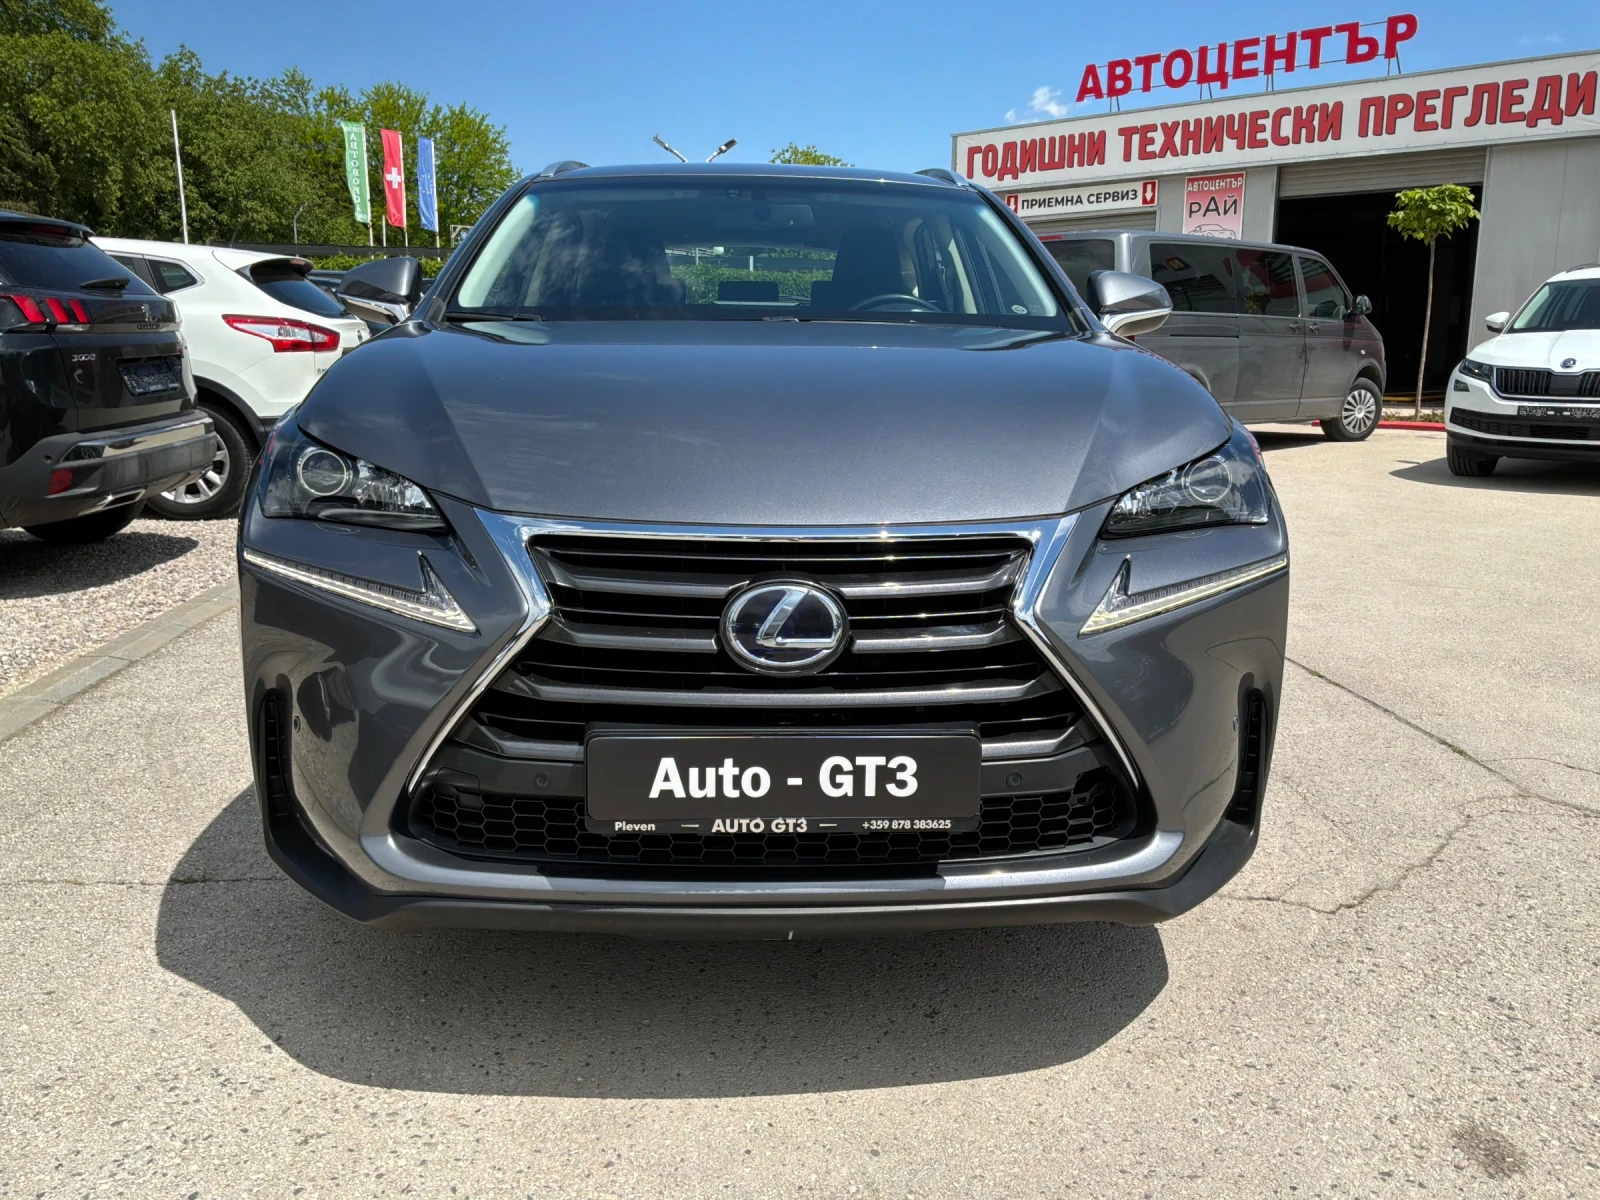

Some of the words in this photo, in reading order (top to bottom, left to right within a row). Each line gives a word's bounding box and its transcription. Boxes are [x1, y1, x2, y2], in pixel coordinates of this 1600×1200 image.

[1075, 13, 1419, 103] АВТОЦЕНТЪР
[966, 130, 1107, 182] ГОДИШНИ
[1118, 101, 1344, 162] ТЕХНИЧЕСКИ
[1358, 70, 1598, 138] ПРЕГЛЕДИ
[1021, 194, 1084, 210] ПРИЕМНА
[1086, 189, 1139, 204] СЕРВИЗ
[1187, 178, 1244, 192] АВТОЦЕНТЪР
[649, 757, 771, 798] Auto
[819, 755, 918, 798] GT3
[614, 821, 656, 833] Pleven
[711, 818, 765, 833] AUTO
[771, 818, 808, 833] GT3
[862, 820, 891, 830] +359
[892, 820, 911, 829] 878
[913, 819, 952, 829] 383625
